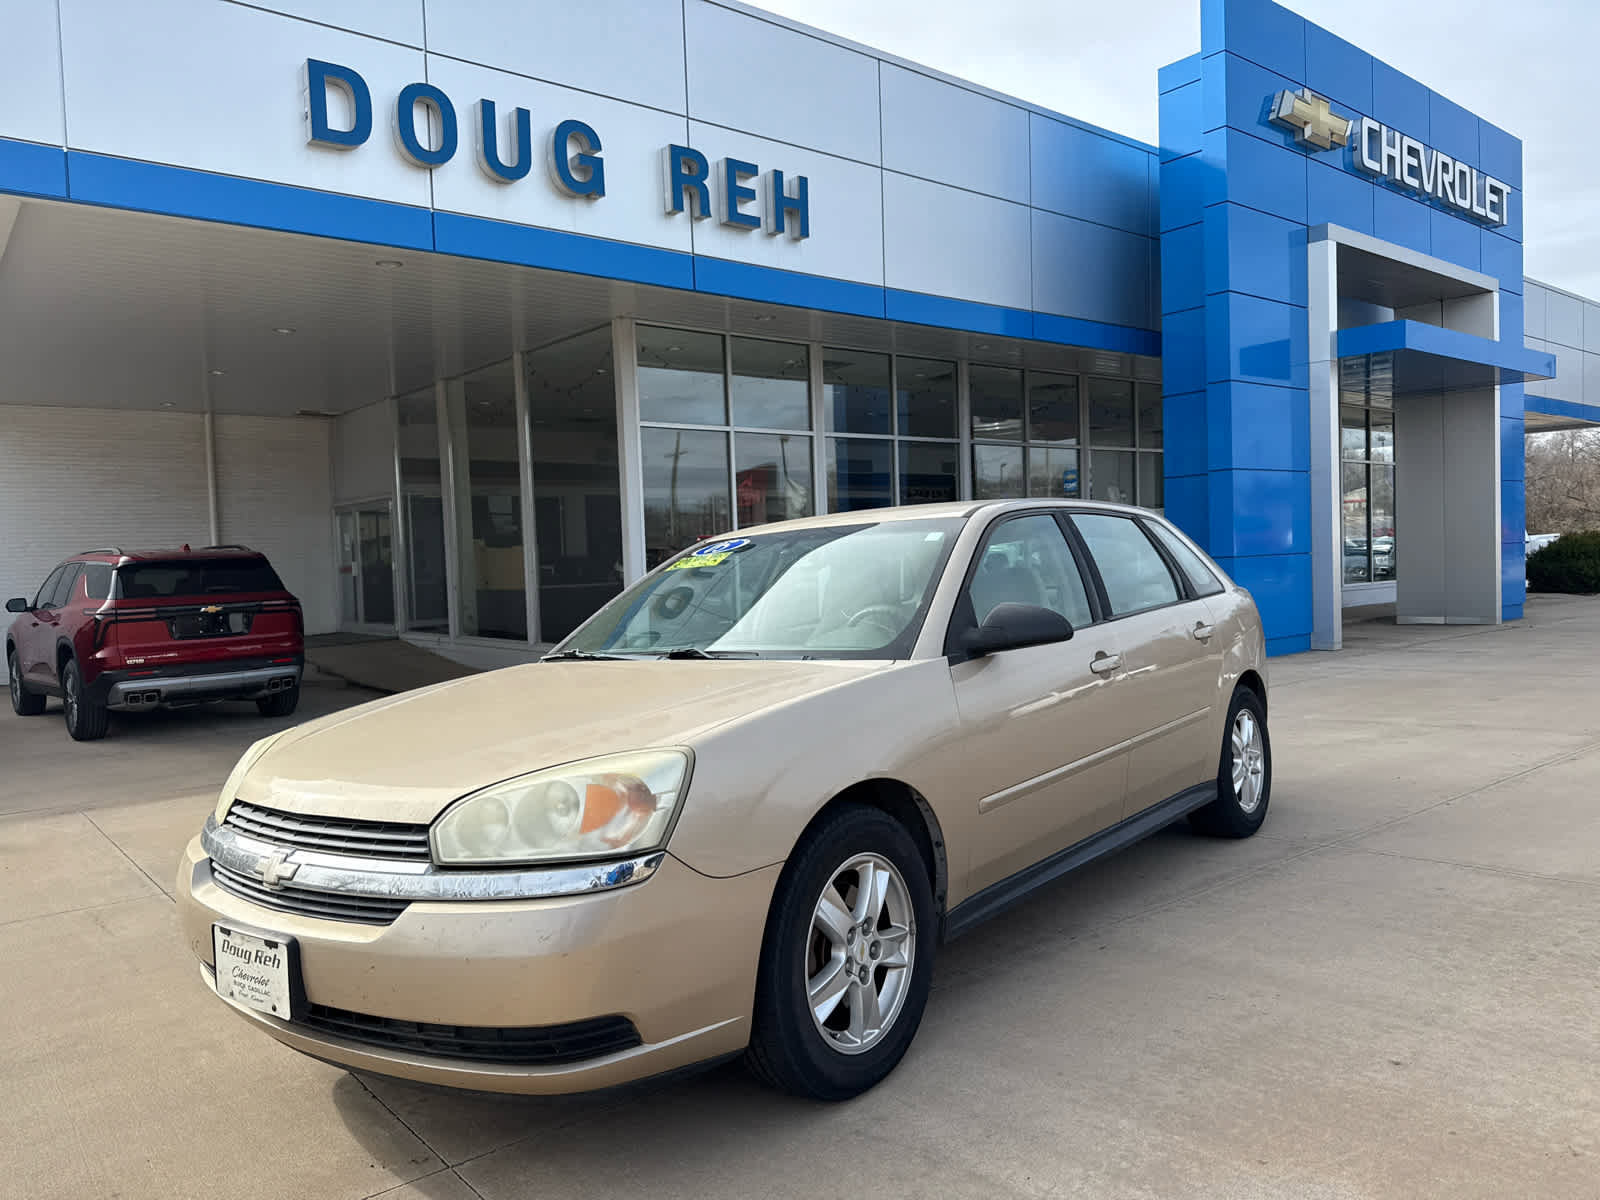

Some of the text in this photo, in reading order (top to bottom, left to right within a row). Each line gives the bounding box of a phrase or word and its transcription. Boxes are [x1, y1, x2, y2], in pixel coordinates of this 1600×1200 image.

[303, 58, 810, 241] DOUG REH
[1361, 116, 1512, 227] CHEVROLET
[222, 939, 281, 969] Doug Reh
[232, 965, 270, 987] Chevrolet
